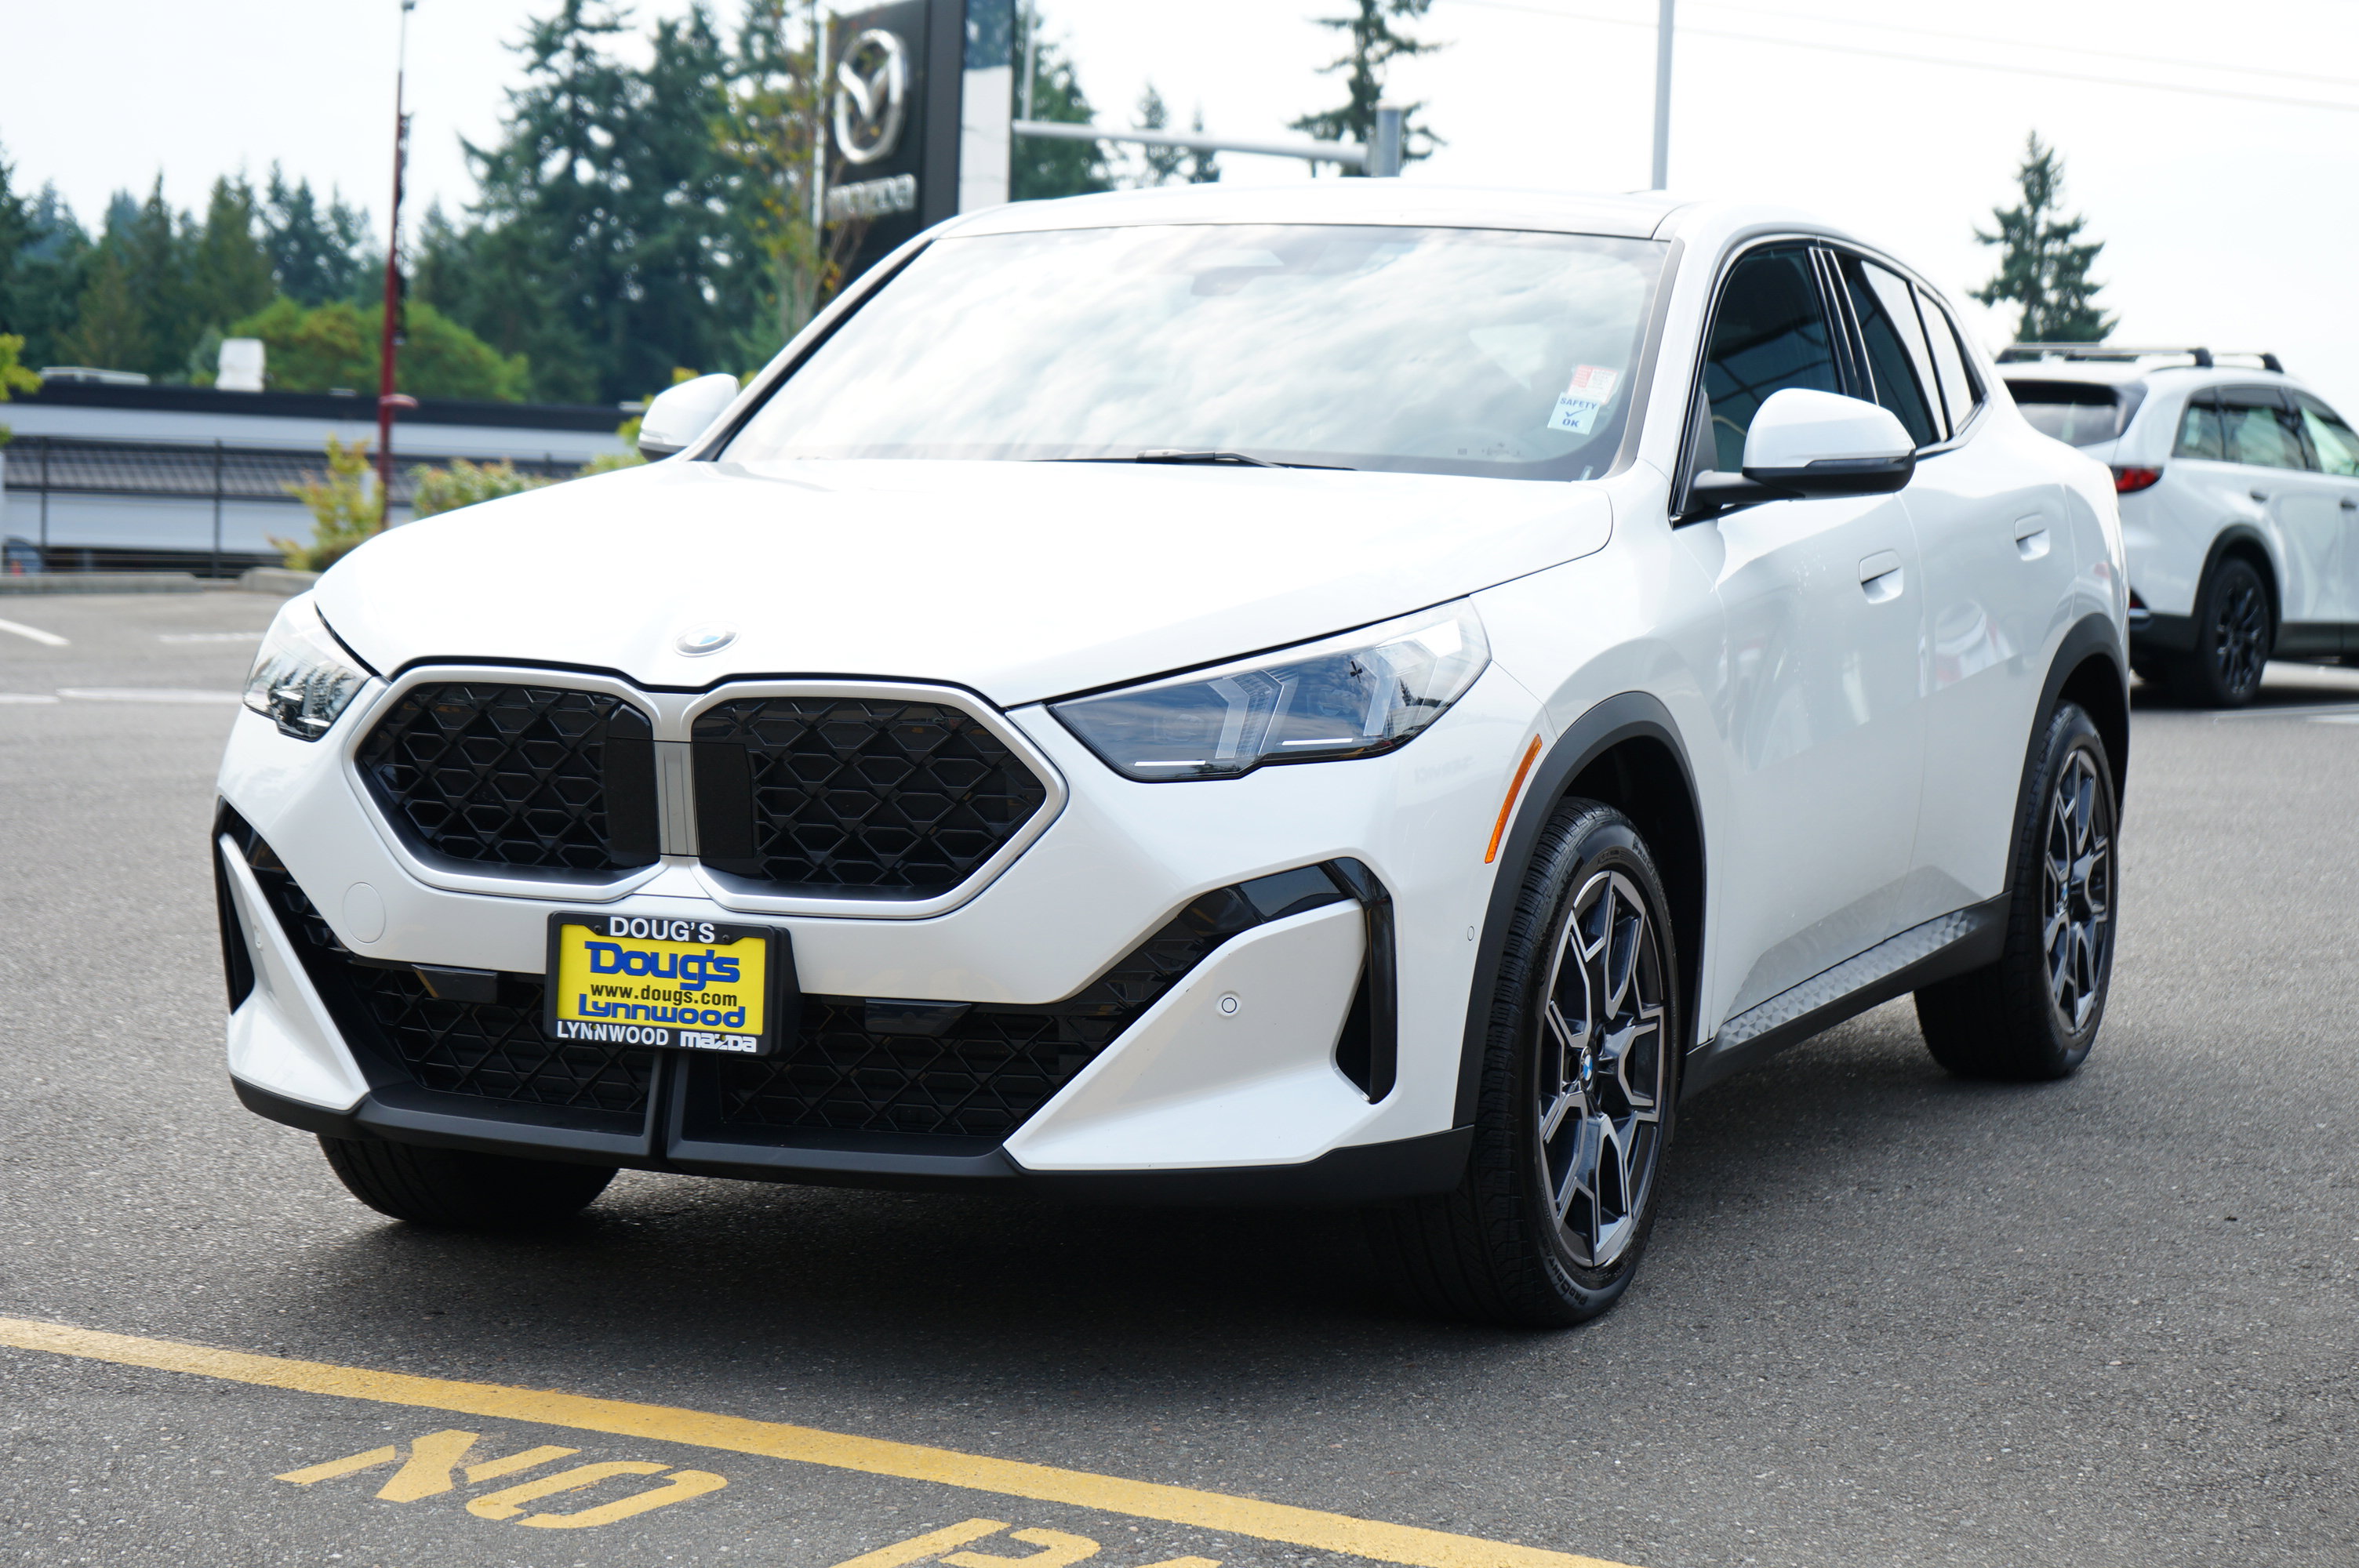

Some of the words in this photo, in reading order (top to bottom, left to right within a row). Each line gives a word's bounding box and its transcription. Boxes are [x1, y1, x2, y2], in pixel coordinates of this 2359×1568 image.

[1560, 397, 1597, 409] SAFETY
[1561, 418, 1579, 427] OK
[609, 916, 715, 943] DOUG'S
[584, 941, 740, 991] Doug's
[590, 984, 737, 1007] www.dougs.com
[578, 993, 745, 1028] Lynnwood
[557, 1021, 669, 1046] LYNNWOOD
